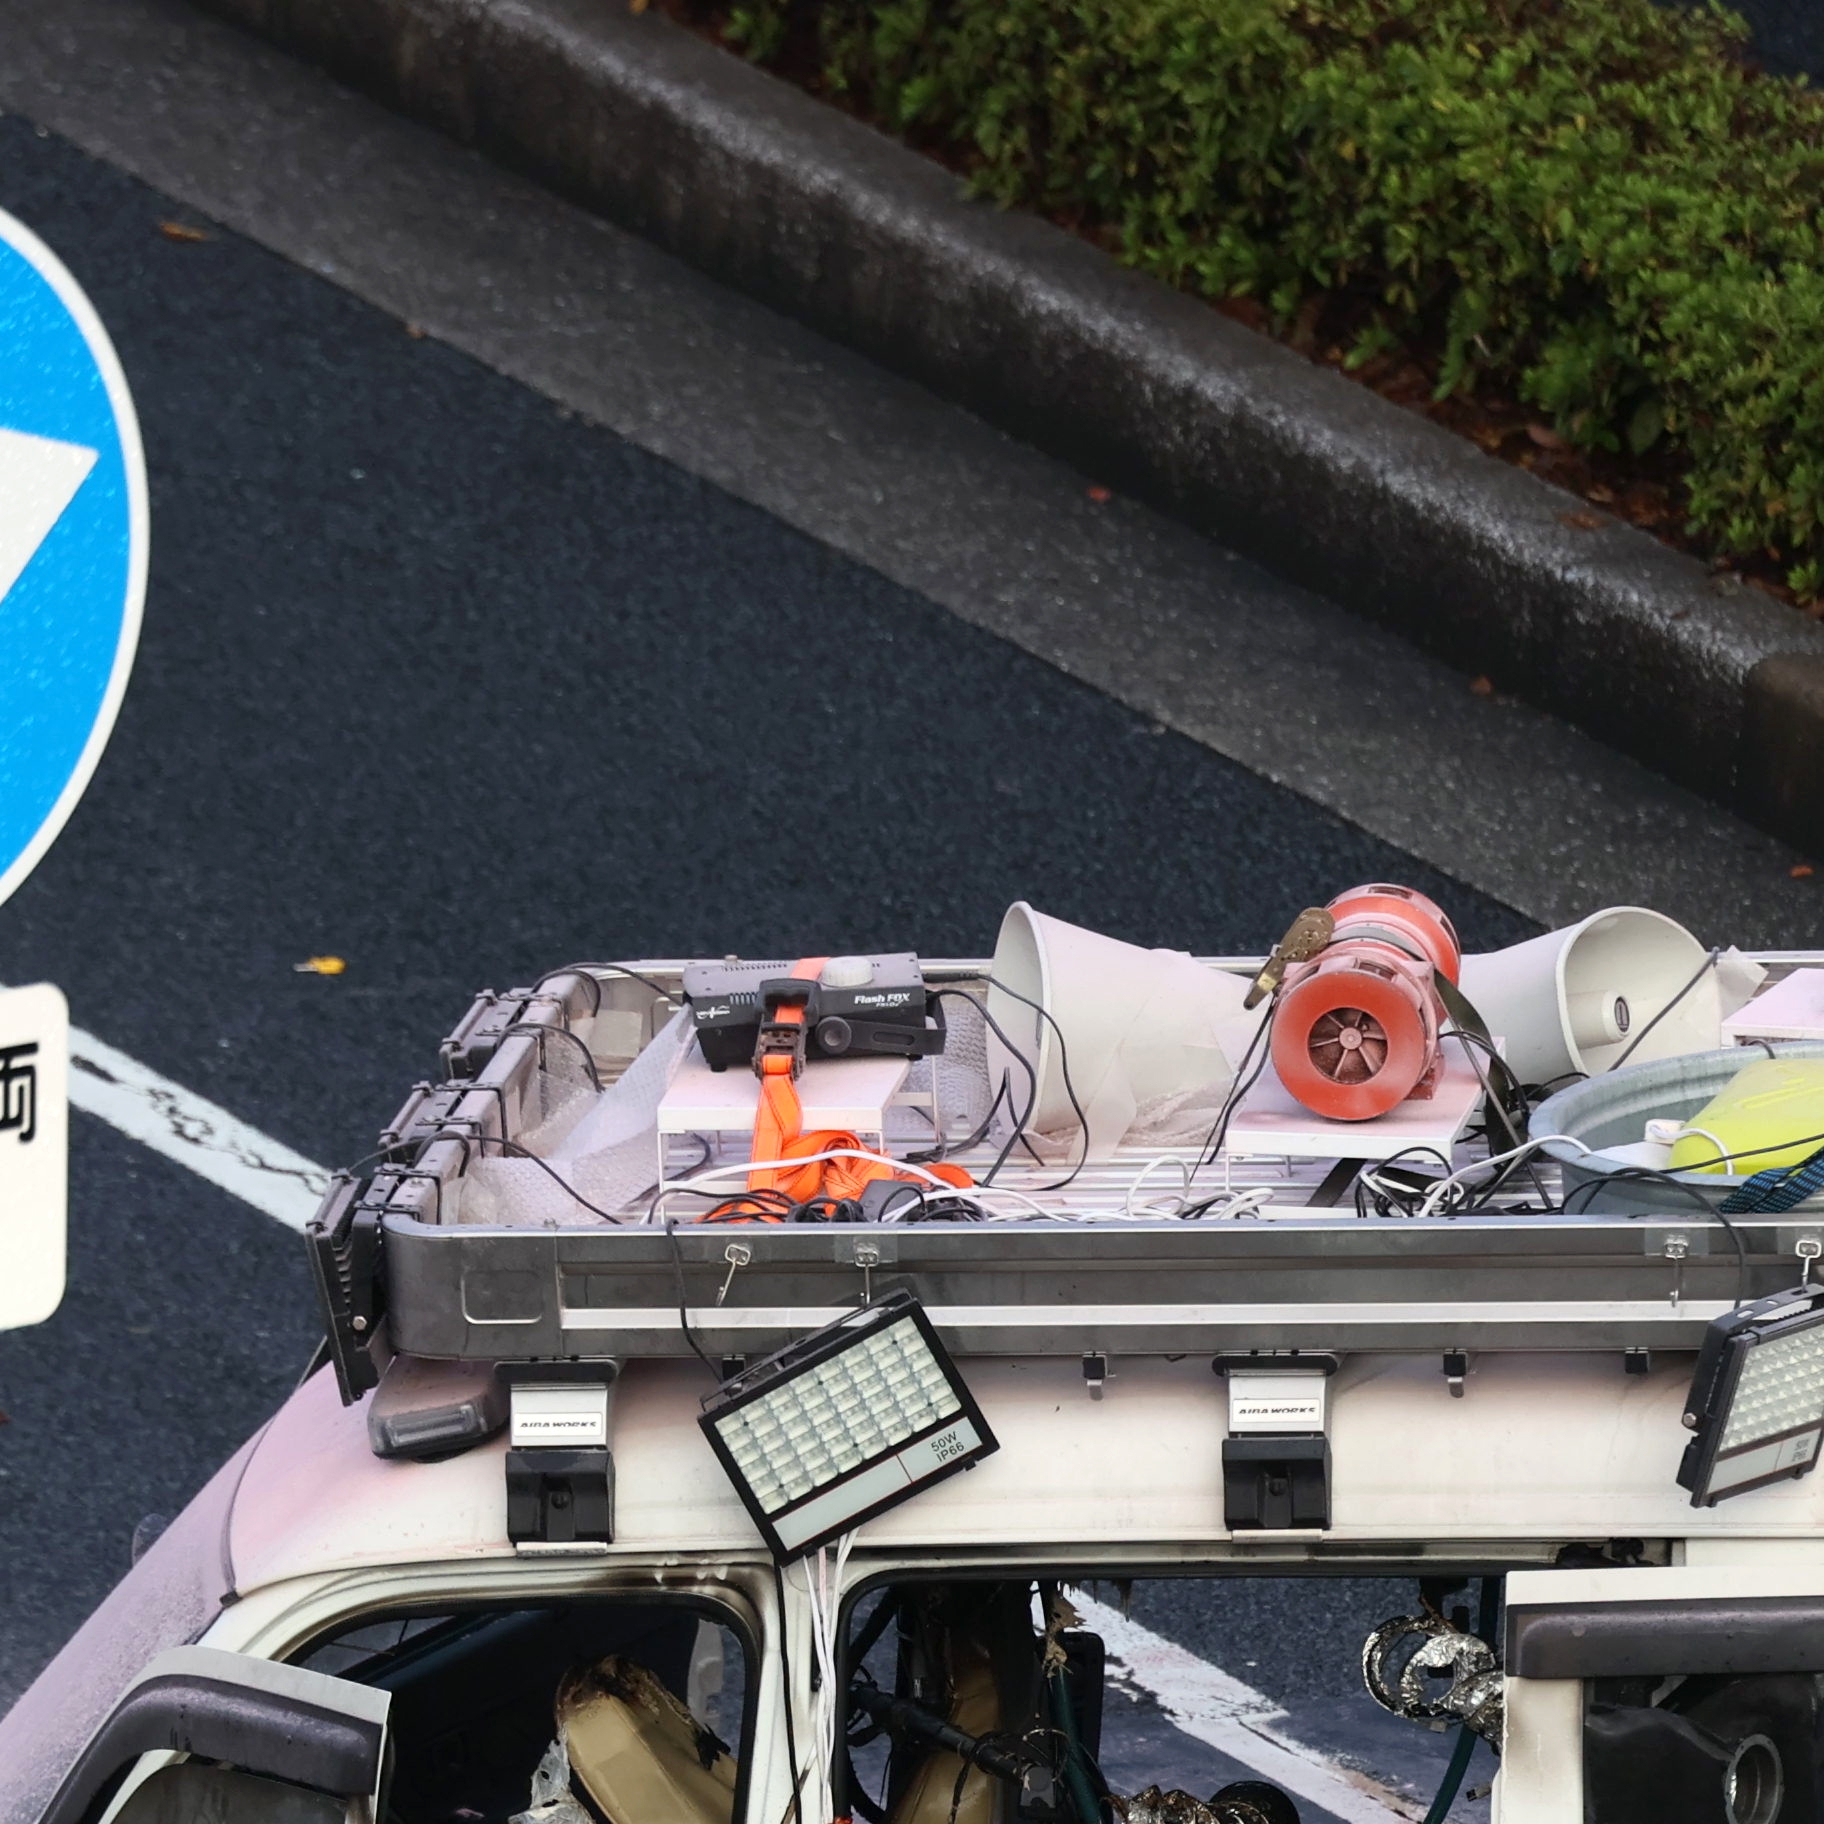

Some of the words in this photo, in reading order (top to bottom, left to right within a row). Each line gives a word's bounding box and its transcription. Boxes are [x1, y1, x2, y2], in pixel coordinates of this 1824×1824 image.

[854, 994, 886, 1004] Flash
[887, 992, 911, 1002] FOX
[930, 1431, 957, 1452] 50W
[936, 1442, 965, 1462] IP66
